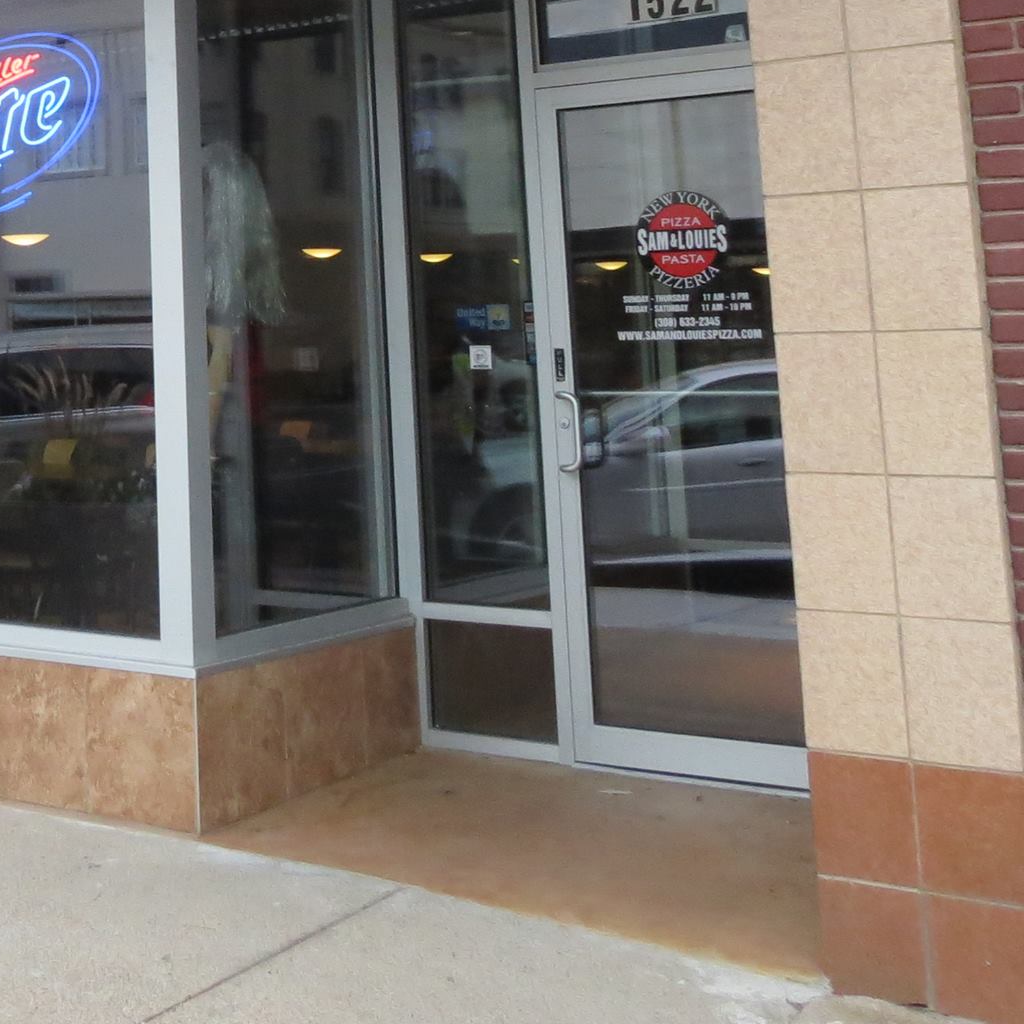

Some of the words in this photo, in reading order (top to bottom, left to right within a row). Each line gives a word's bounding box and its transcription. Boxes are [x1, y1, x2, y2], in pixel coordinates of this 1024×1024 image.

[640, 191, 674, 223] NEW
[677, 191, 721, 222] YORK
[661, 216, 702, 228] PIZZA
[661, 253, 706, 265] PASTA
[649, 264, 721, 290] PIZZERIA
[702, 293, 712, 301] 11
[712, 292, 725, 301] AM
[736, 291, 750, 301] PM
[456, 307, 486, 318] United
[701, 303, 711, 312] 11
[711, 303, 724, 312] AM
[739, 302, 753, 311] PM
